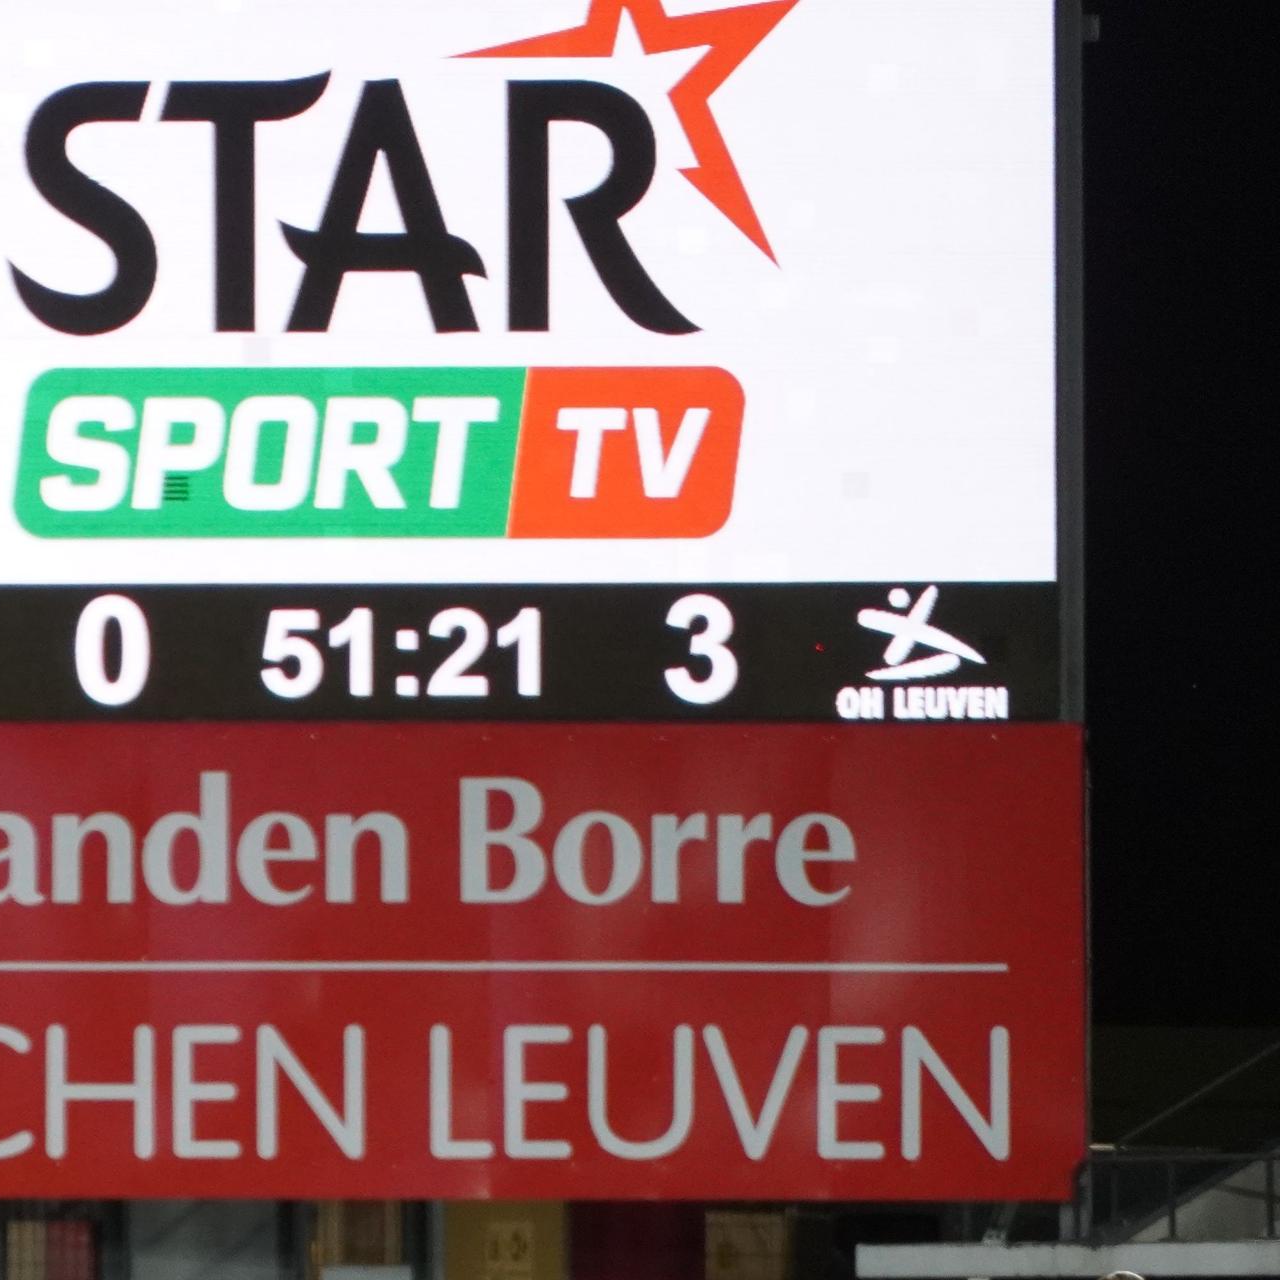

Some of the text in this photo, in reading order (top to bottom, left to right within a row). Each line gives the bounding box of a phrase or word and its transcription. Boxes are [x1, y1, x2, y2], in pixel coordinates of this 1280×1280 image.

[8, 69, 703, 336] STAR
[38, 395, 712, 511] SPORT TV
[75, 594, 738, 706] 0 51:21 3
[836, 686, 1008, 720] OH LEUVEN
[458, 776, 857, 907] Borre
[429, 1023, 1011, 1161] LEUVEN
